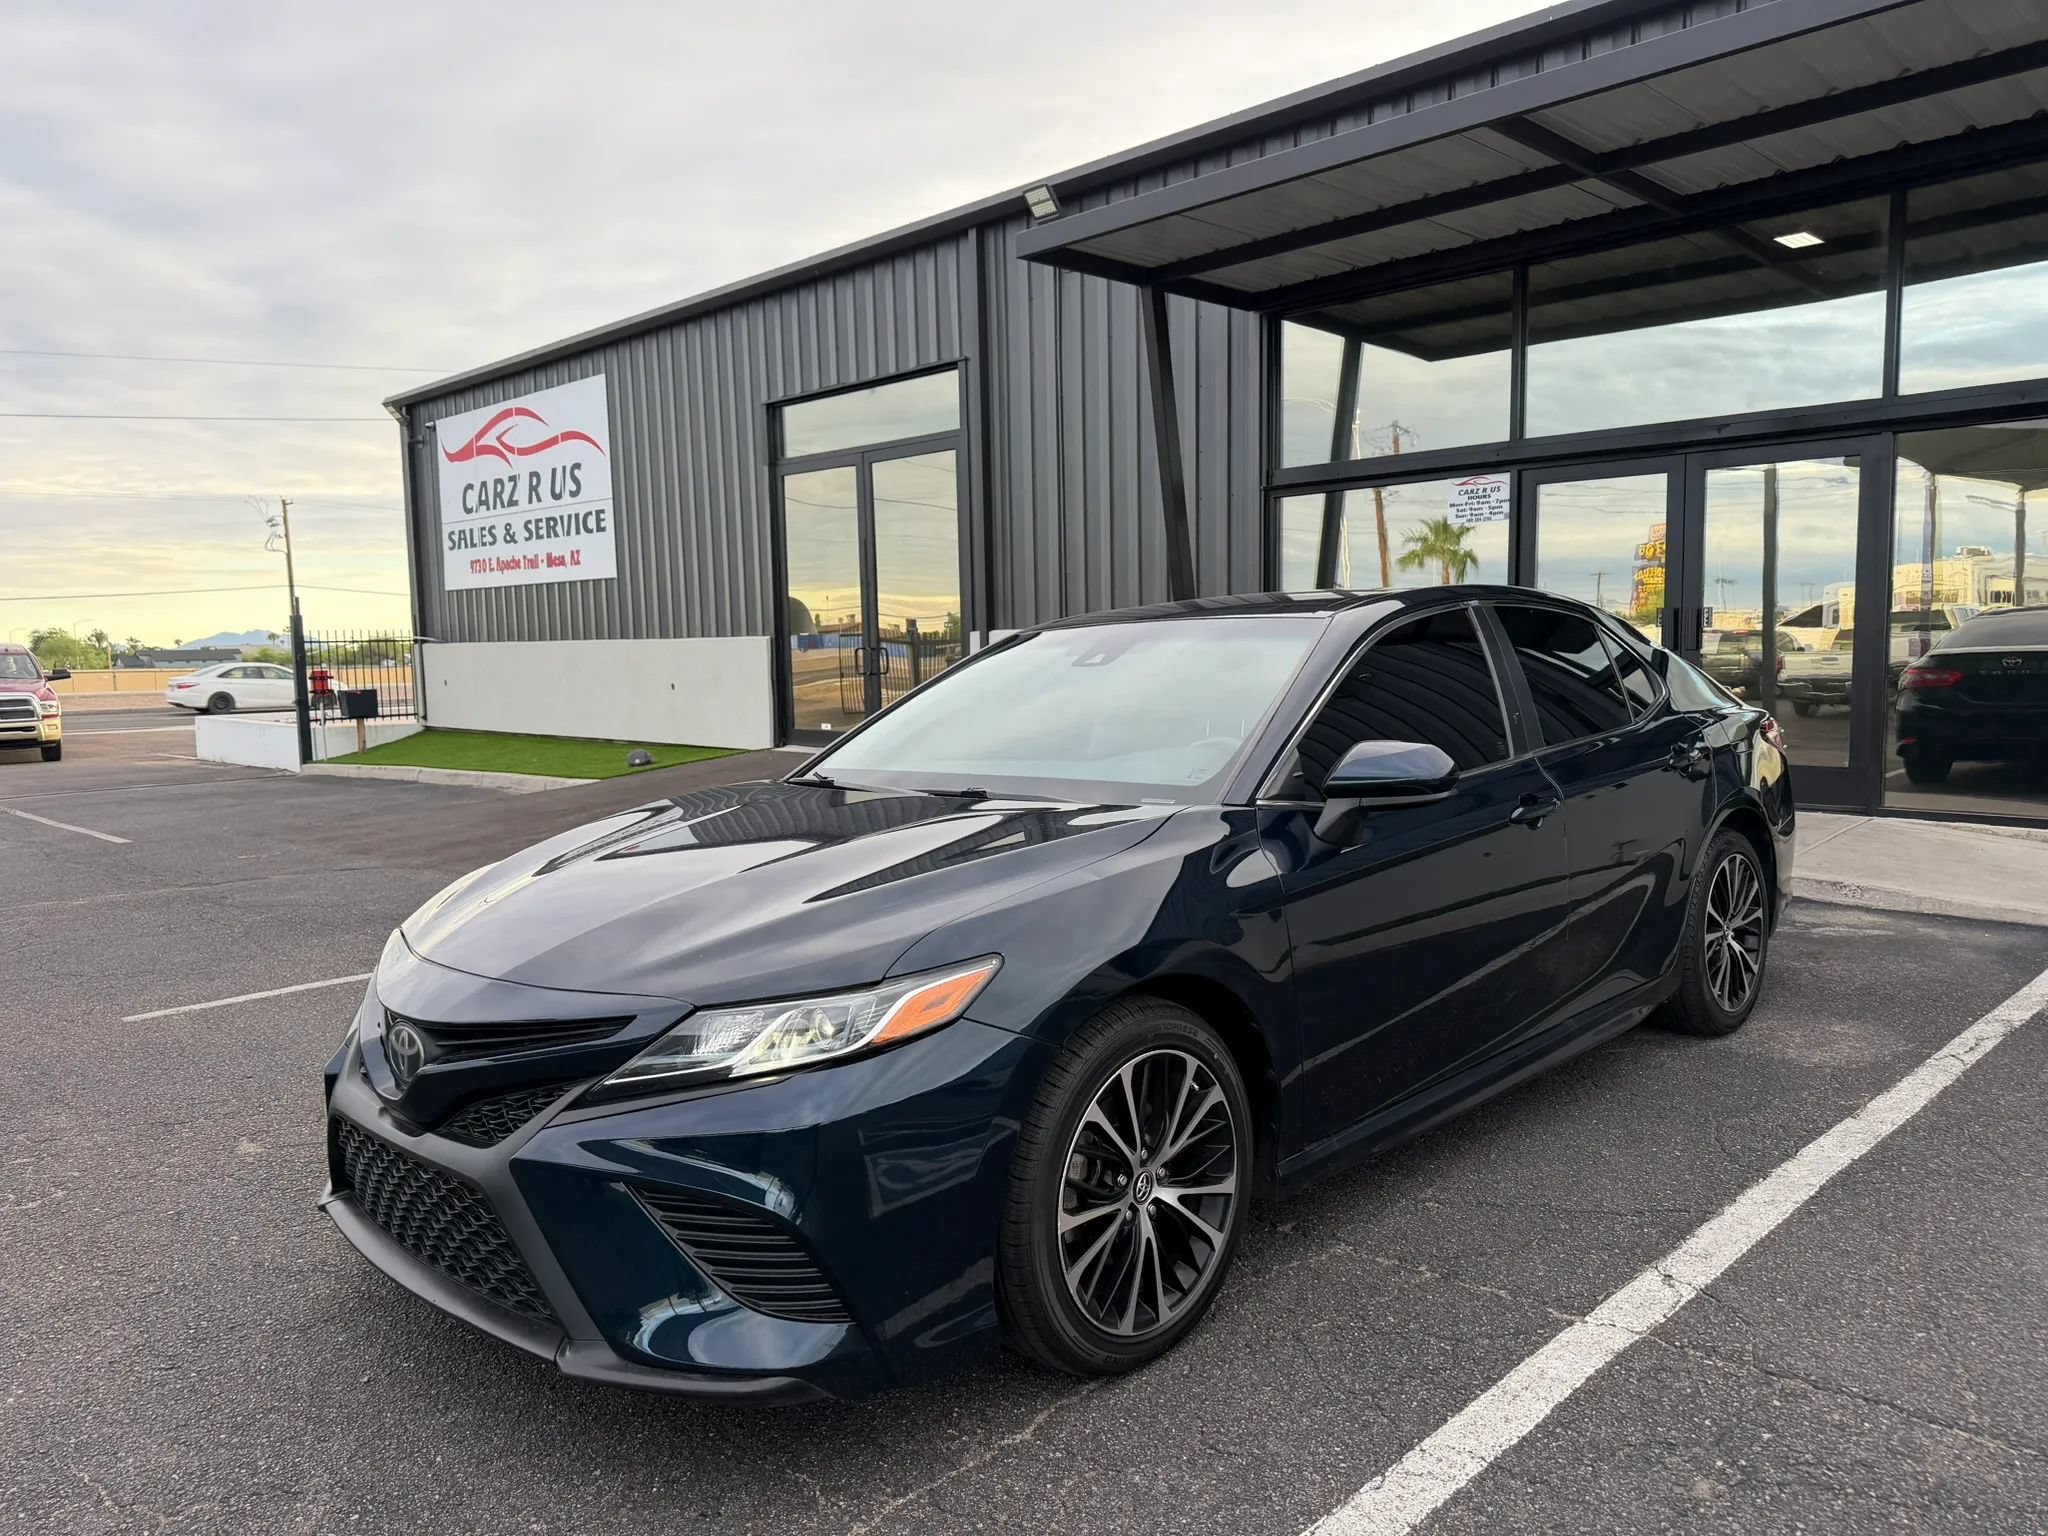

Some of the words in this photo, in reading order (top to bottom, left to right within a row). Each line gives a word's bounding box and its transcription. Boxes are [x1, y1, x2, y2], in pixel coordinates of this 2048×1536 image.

[462, 474, 520, 515] CARZ
[528, 471, 542, 504] R
[550, 462, 582, 501] US
[447, 525, 497, 551] SALES
[503, 523, 518, 544] &
[523, 509, 607, 542] SERVICE
[470, 558, 487, 574] 9730
[488, 558, 495, 572] E.
[496, 556, 521, 574] Apache
[523, 554, 539, 570] Trail
[570, 549, 581, 566] AZ
